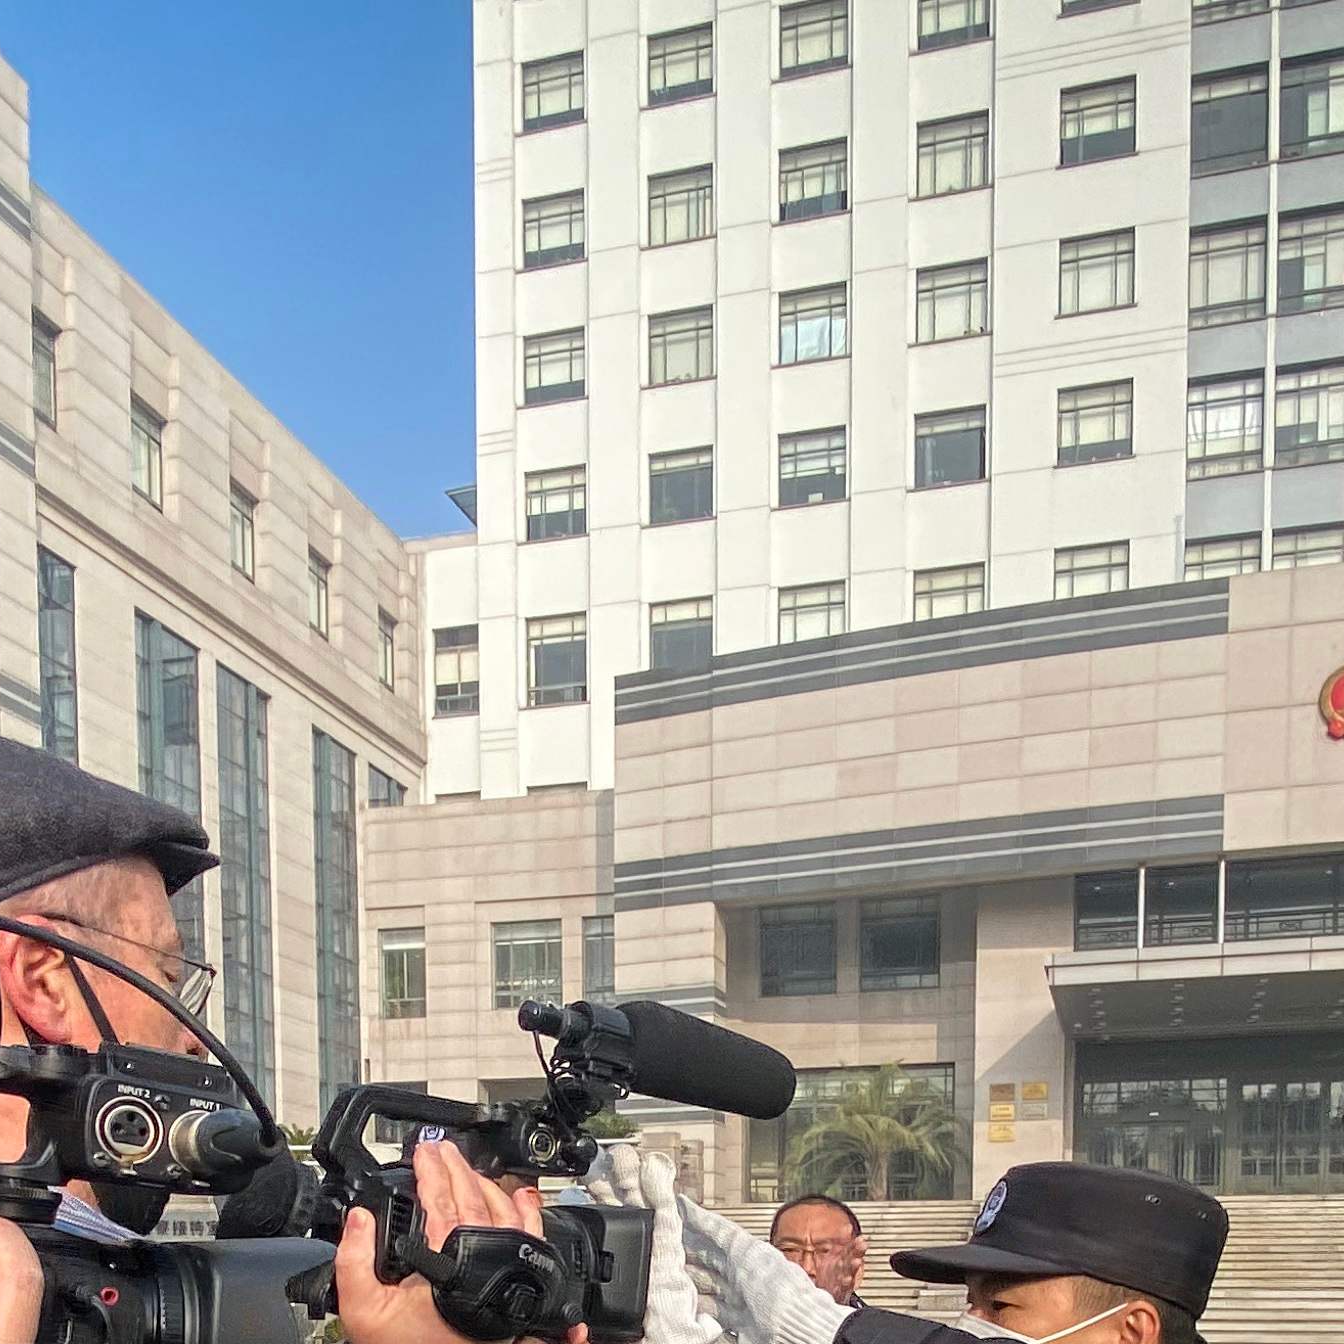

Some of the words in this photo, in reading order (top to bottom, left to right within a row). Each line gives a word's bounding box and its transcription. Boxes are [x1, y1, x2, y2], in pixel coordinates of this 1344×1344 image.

[118, 1084, 145, 1098] INPUT
[145, 1089, 151, 1099] 2
[190, 1098, 214, 1110] INPUT
